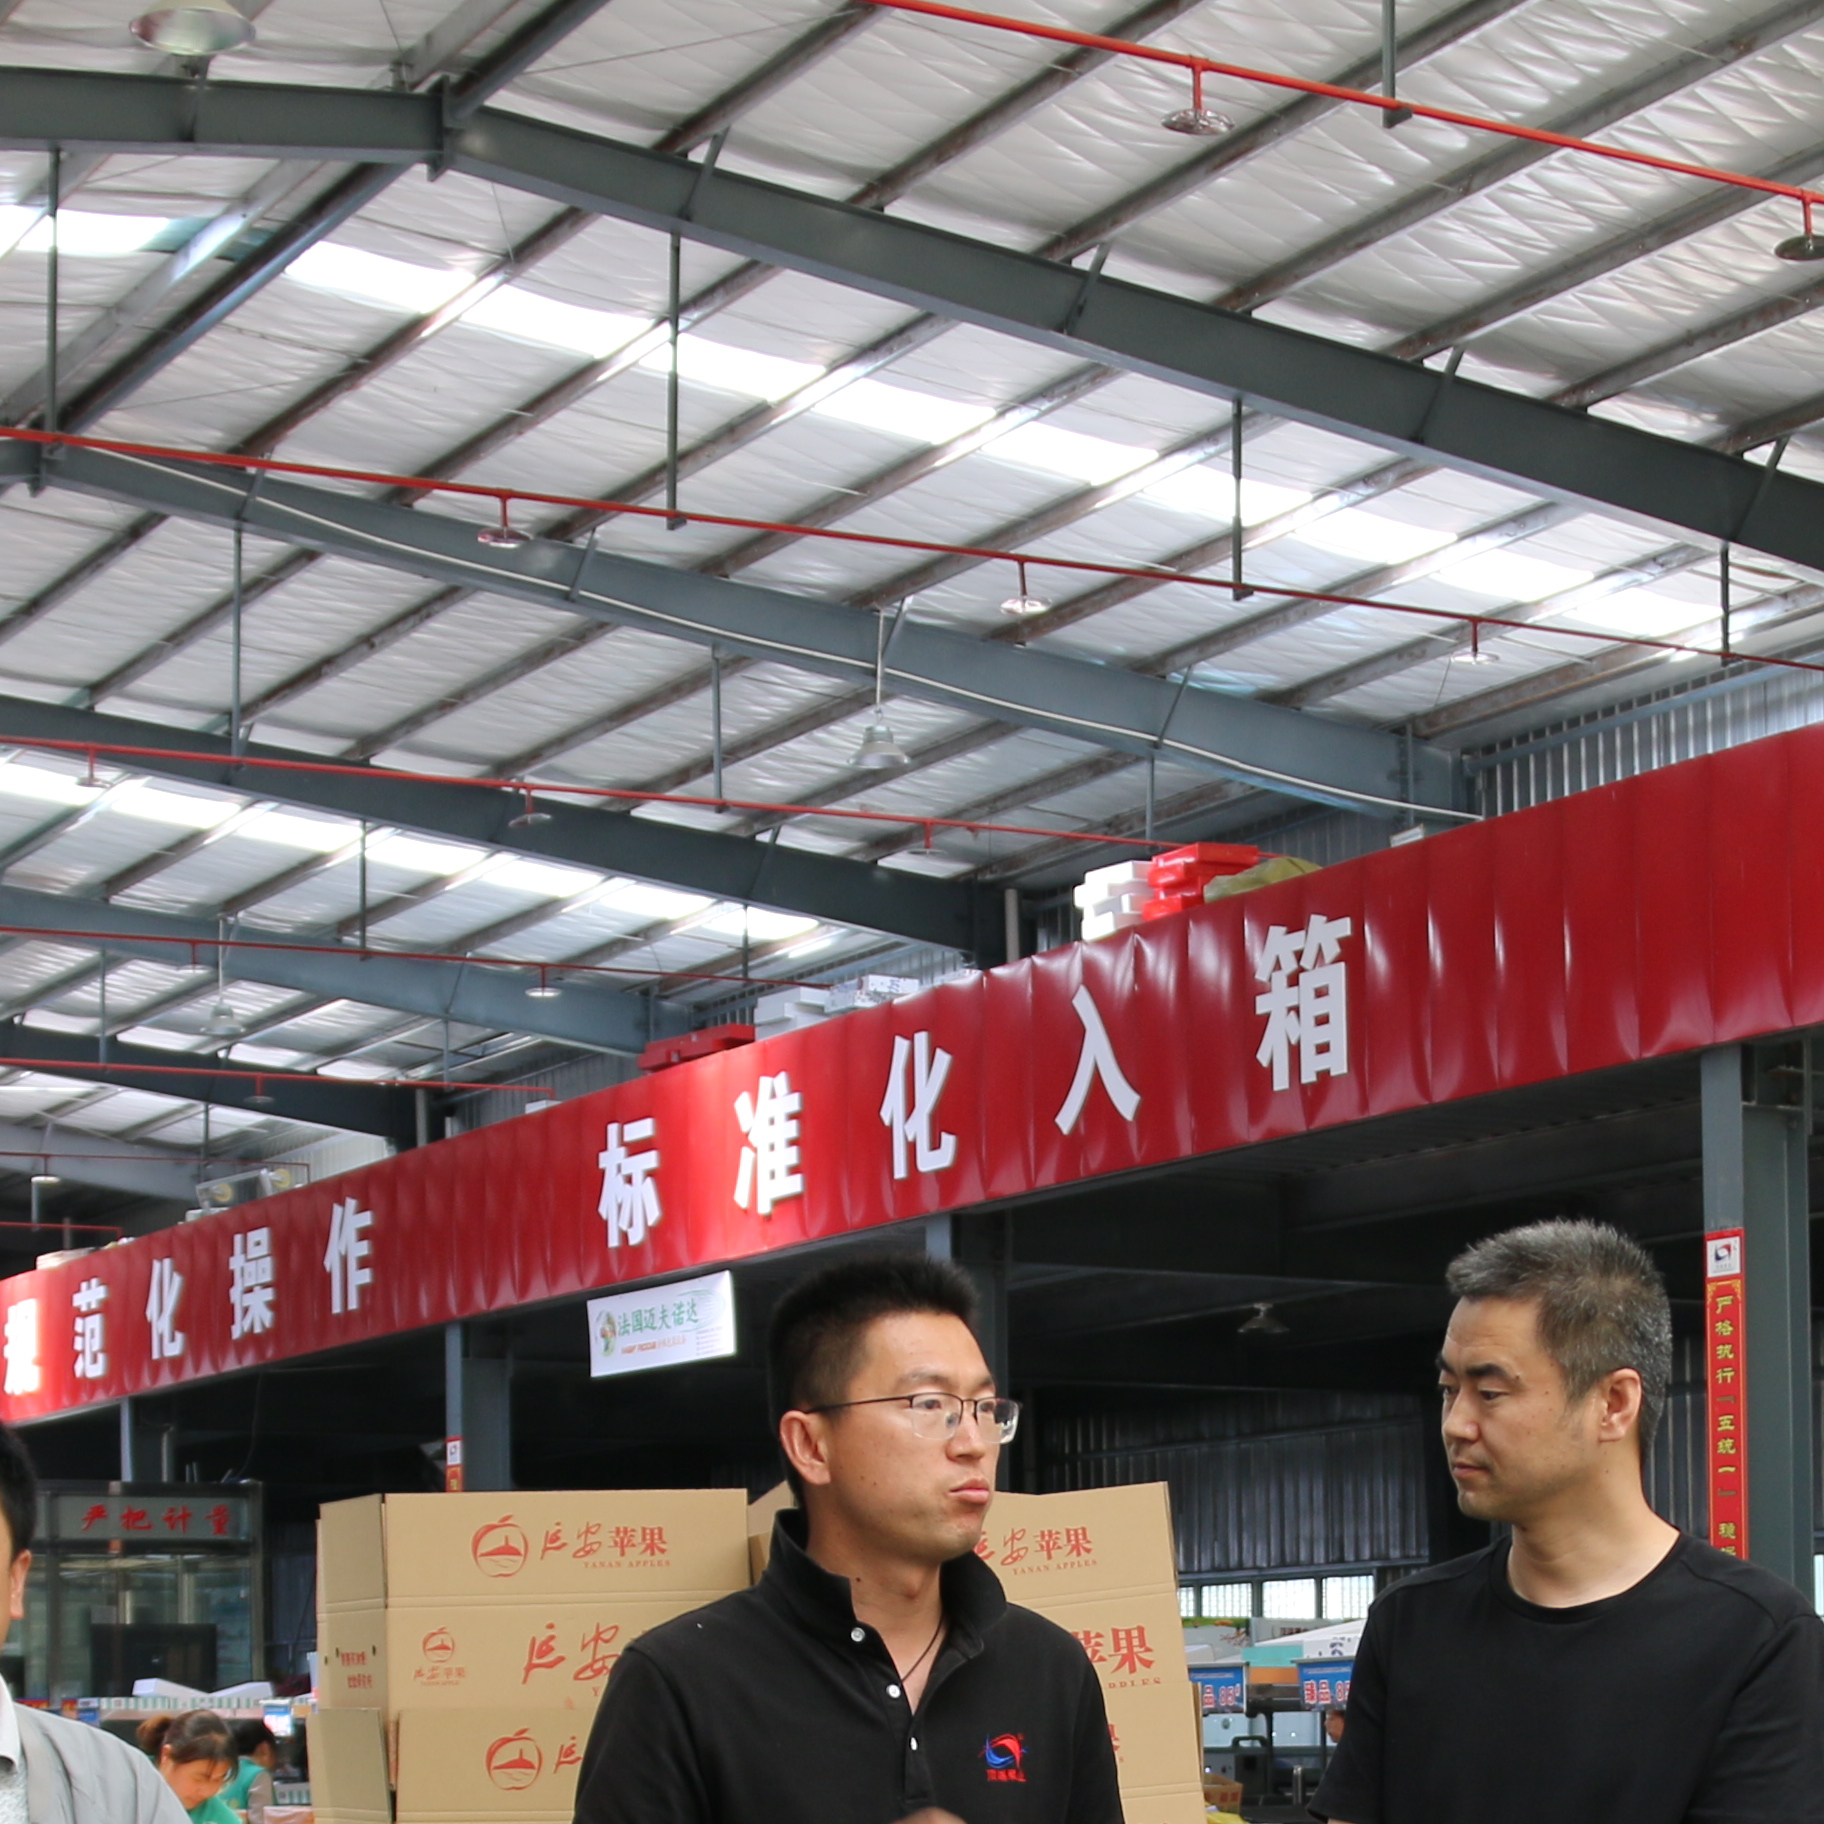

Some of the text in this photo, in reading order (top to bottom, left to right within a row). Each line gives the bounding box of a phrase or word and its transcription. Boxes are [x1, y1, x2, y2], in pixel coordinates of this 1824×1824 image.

[3, 1196, 374, 1396] 规范化操作
[598, 914, 1352, 1248] 标准化入箱
[617, 1298, 700, 1336] 法国迈夫诺达
[81, 1504, 232, 1537] 严把计量
[627, 1558, 672, 1568] APPLES
[1056, 1558, 1098, 1570] APPLES
